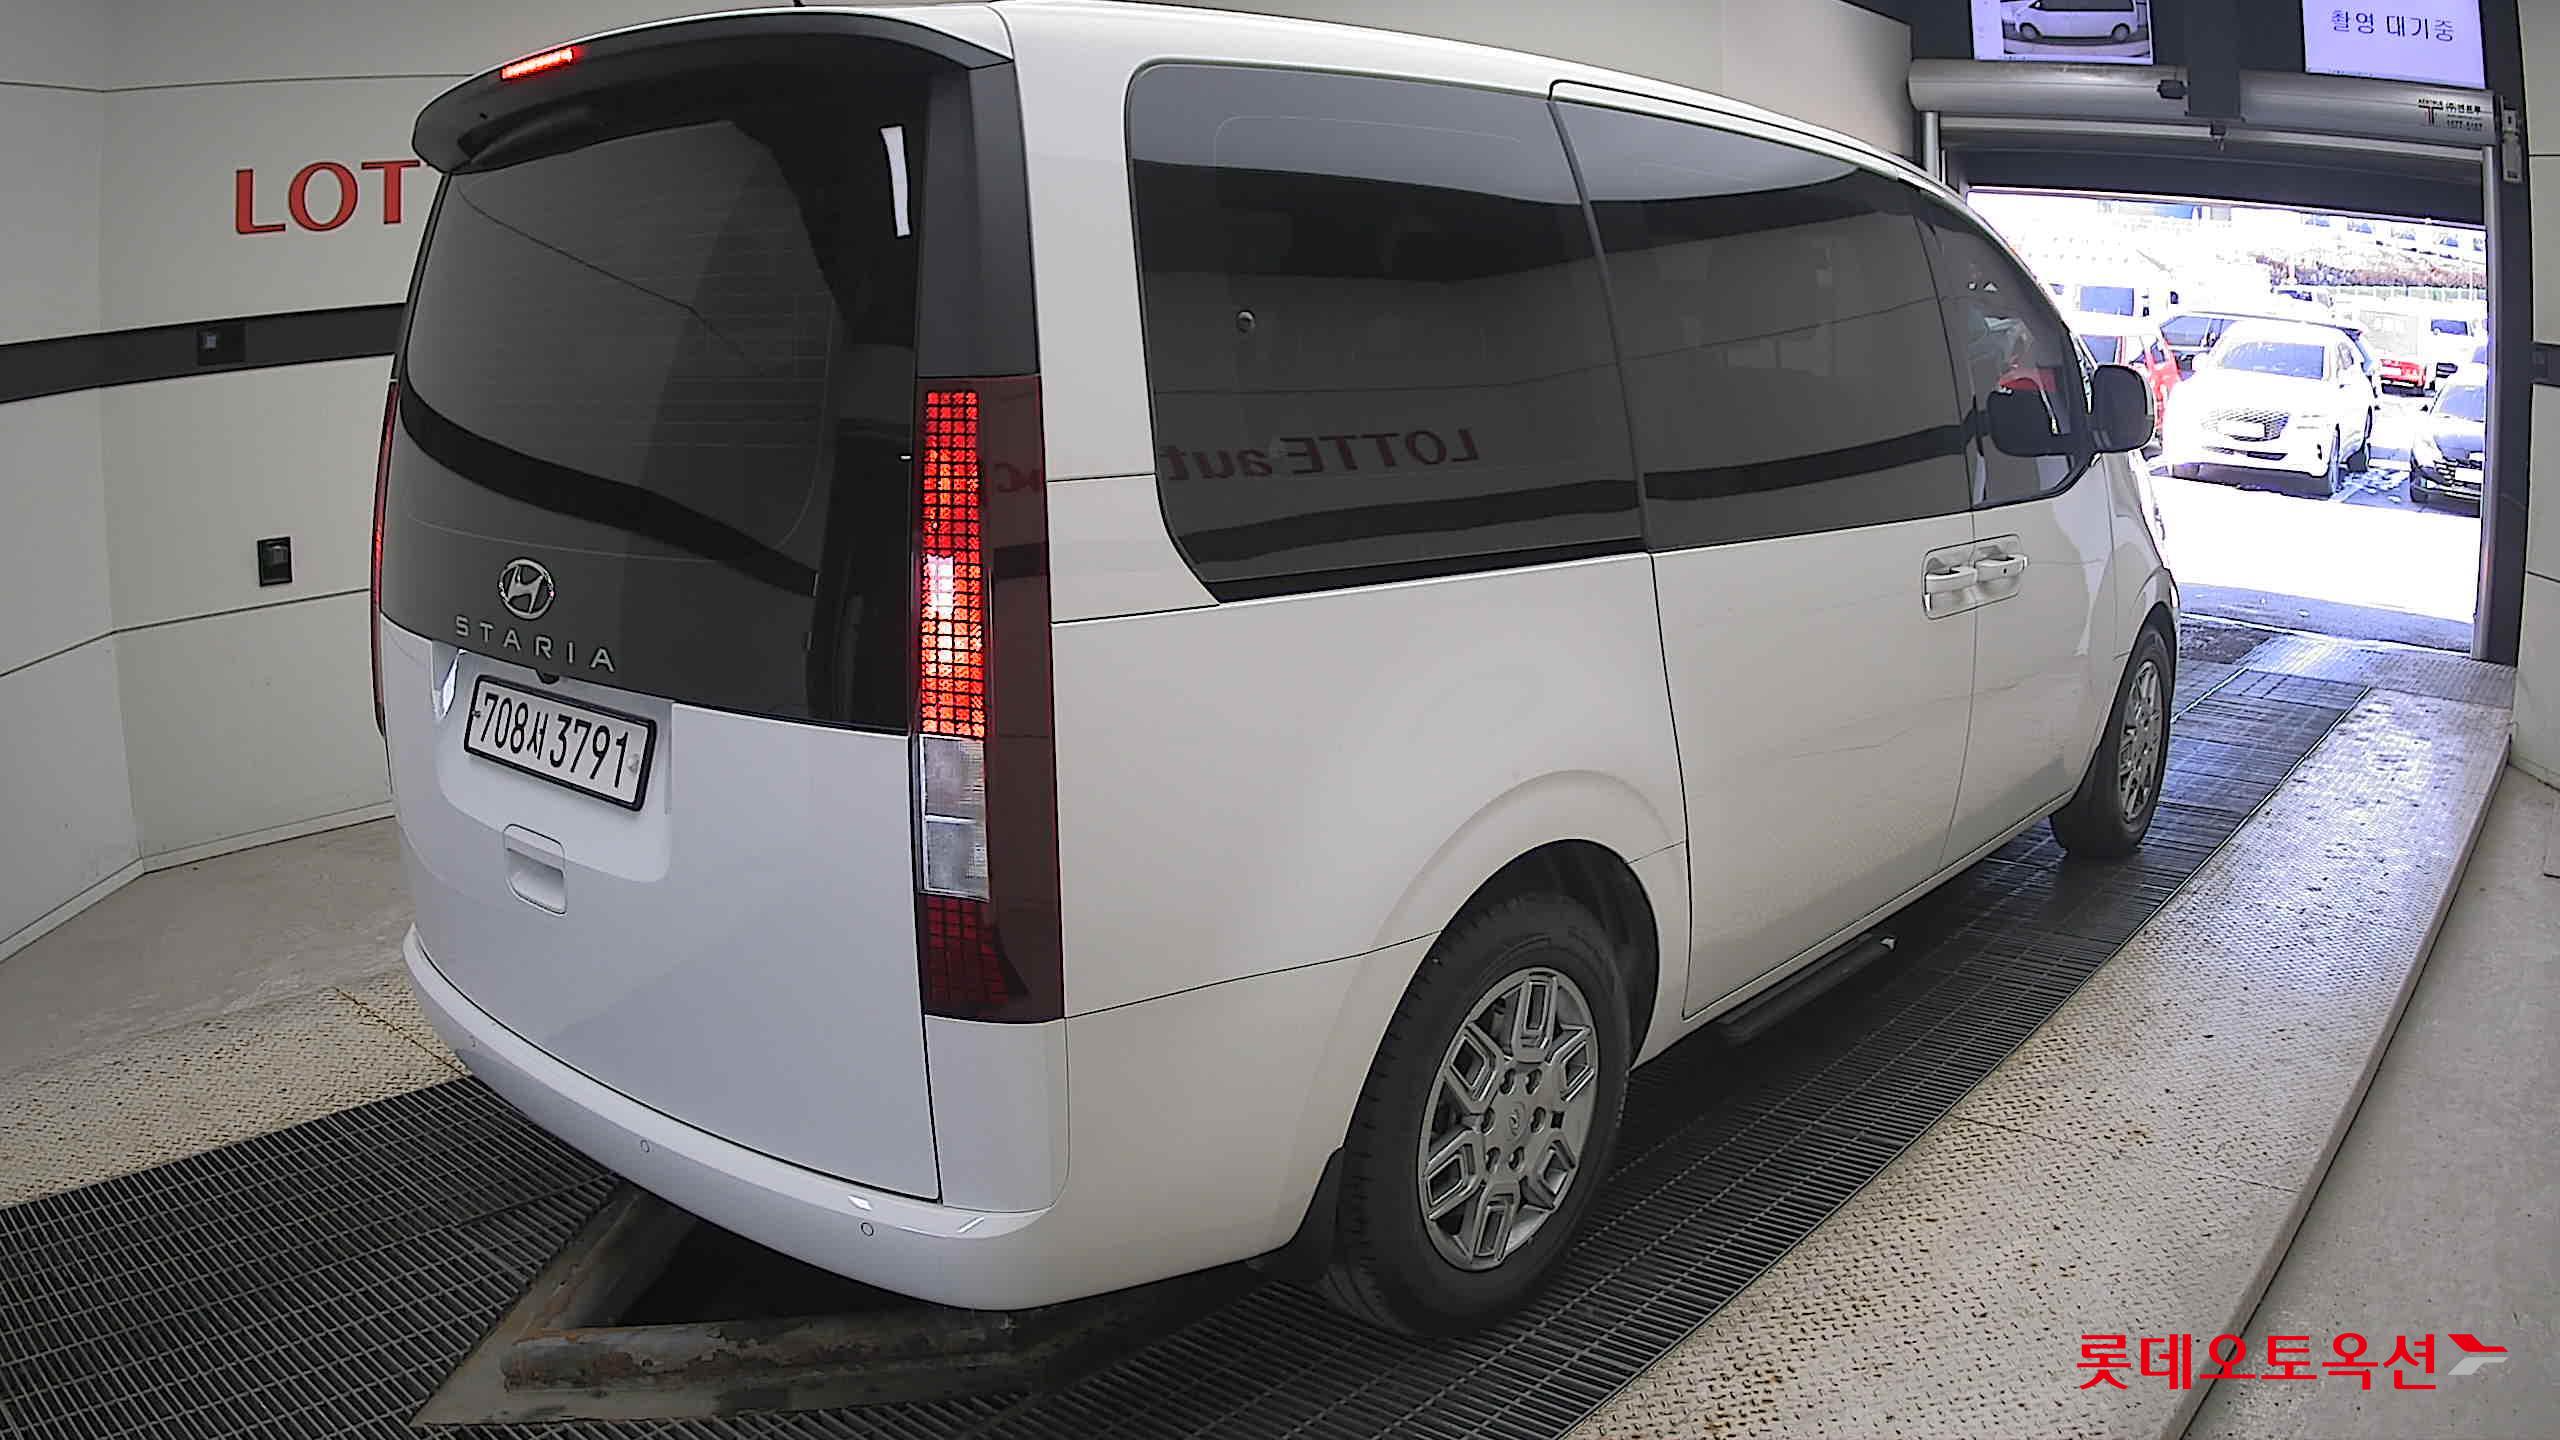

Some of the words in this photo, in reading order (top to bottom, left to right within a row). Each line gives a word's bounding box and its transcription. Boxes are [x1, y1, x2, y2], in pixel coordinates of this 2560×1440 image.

[2331, 9, 2376, 35] 촬영
[2385, 15, 2455, 42] 대기중
[235, 159, 421, 234] LOT
[455, 615, 615, 673] STARIA
